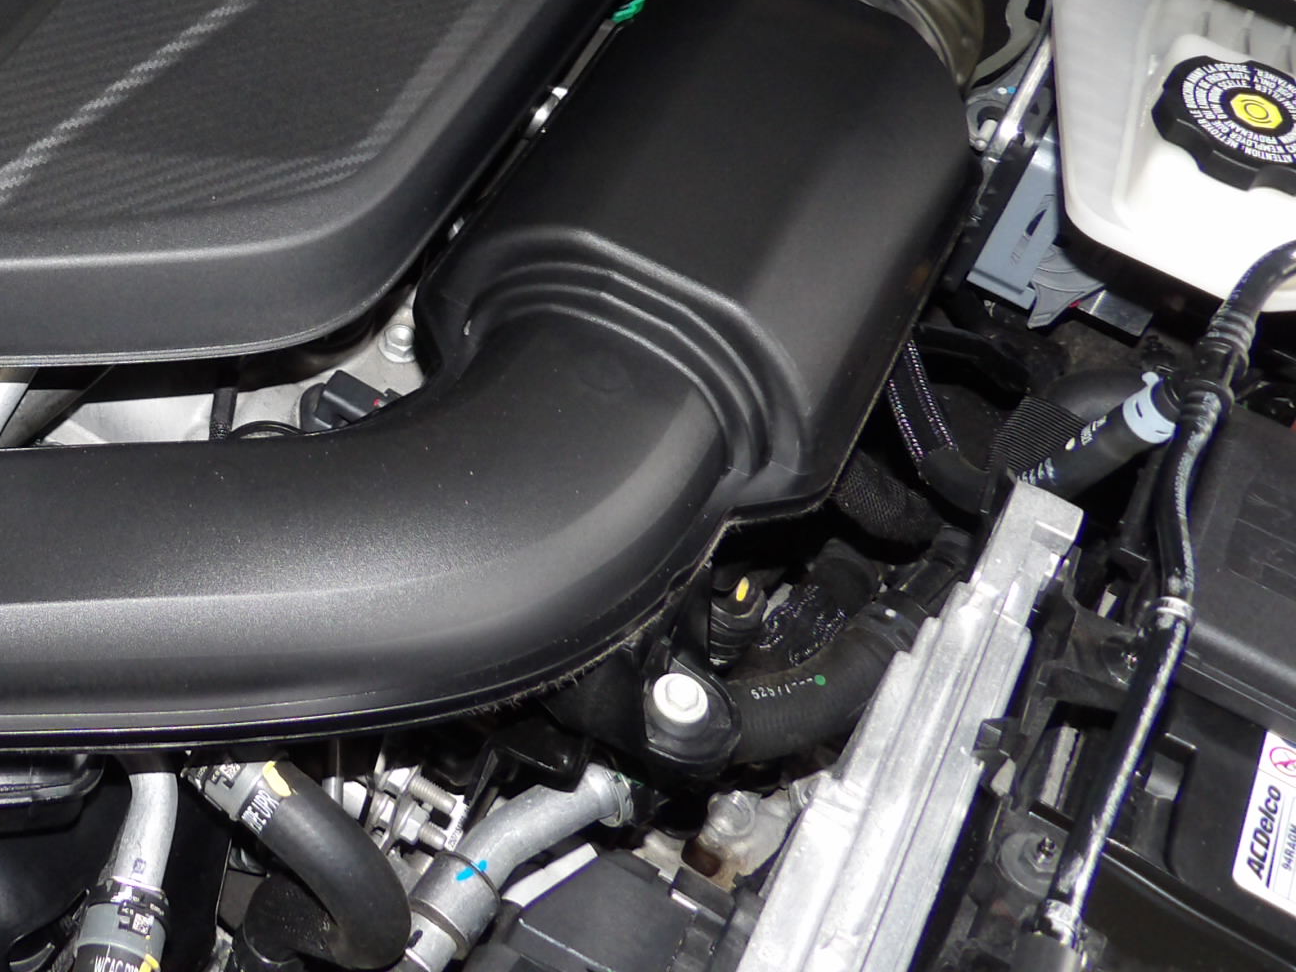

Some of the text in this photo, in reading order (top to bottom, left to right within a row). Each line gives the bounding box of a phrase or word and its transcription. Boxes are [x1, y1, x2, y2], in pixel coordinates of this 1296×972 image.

[1255, 68, 1296, 95] ONTAINER.
[1197, 119, 1240, 149] NETTOYER
[251, 789, 280, 819] UPR
[1245, 784, 1282, 881] ACDelco
